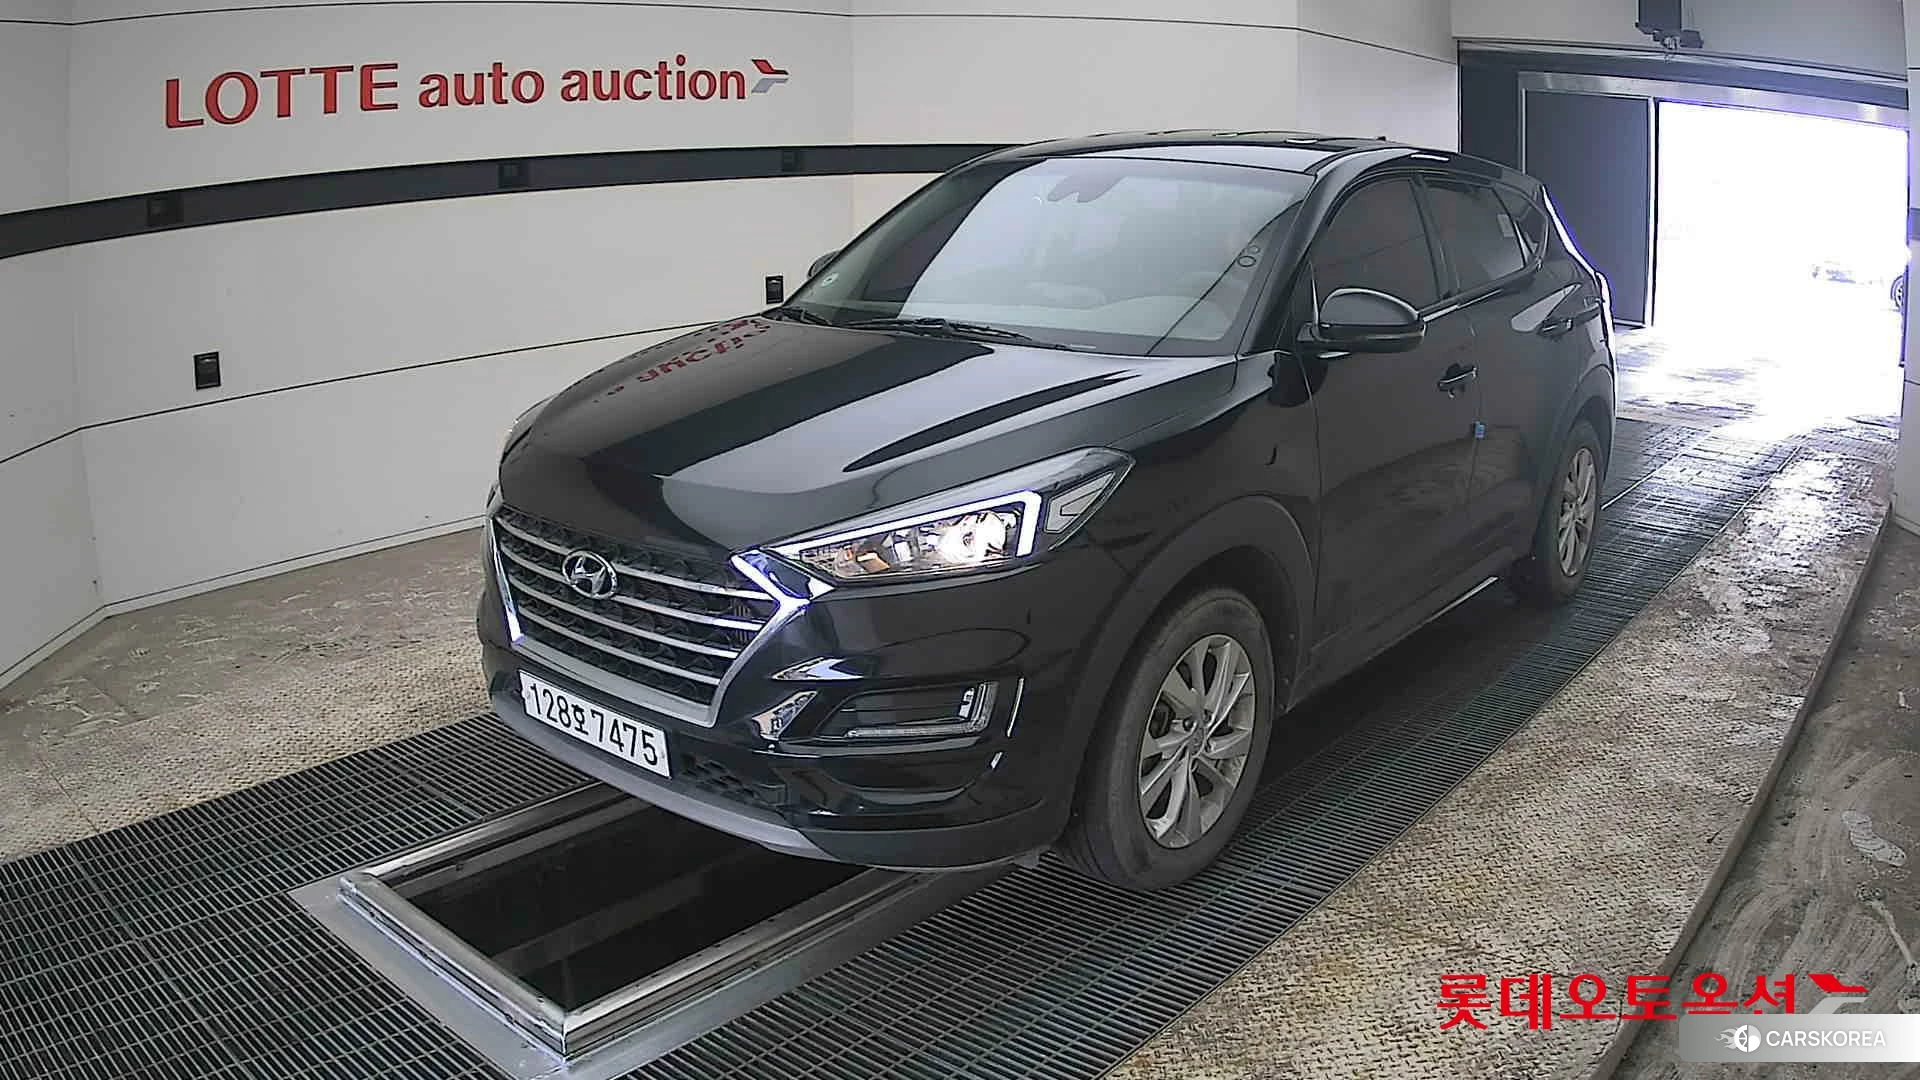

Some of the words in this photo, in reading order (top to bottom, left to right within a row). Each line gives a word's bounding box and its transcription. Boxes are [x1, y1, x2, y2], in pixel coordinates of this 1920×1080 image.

[165, 63, 398, 129] LOTTE
[418, 62, 545, 108] auto
[560, 54, 747, 102] auction
